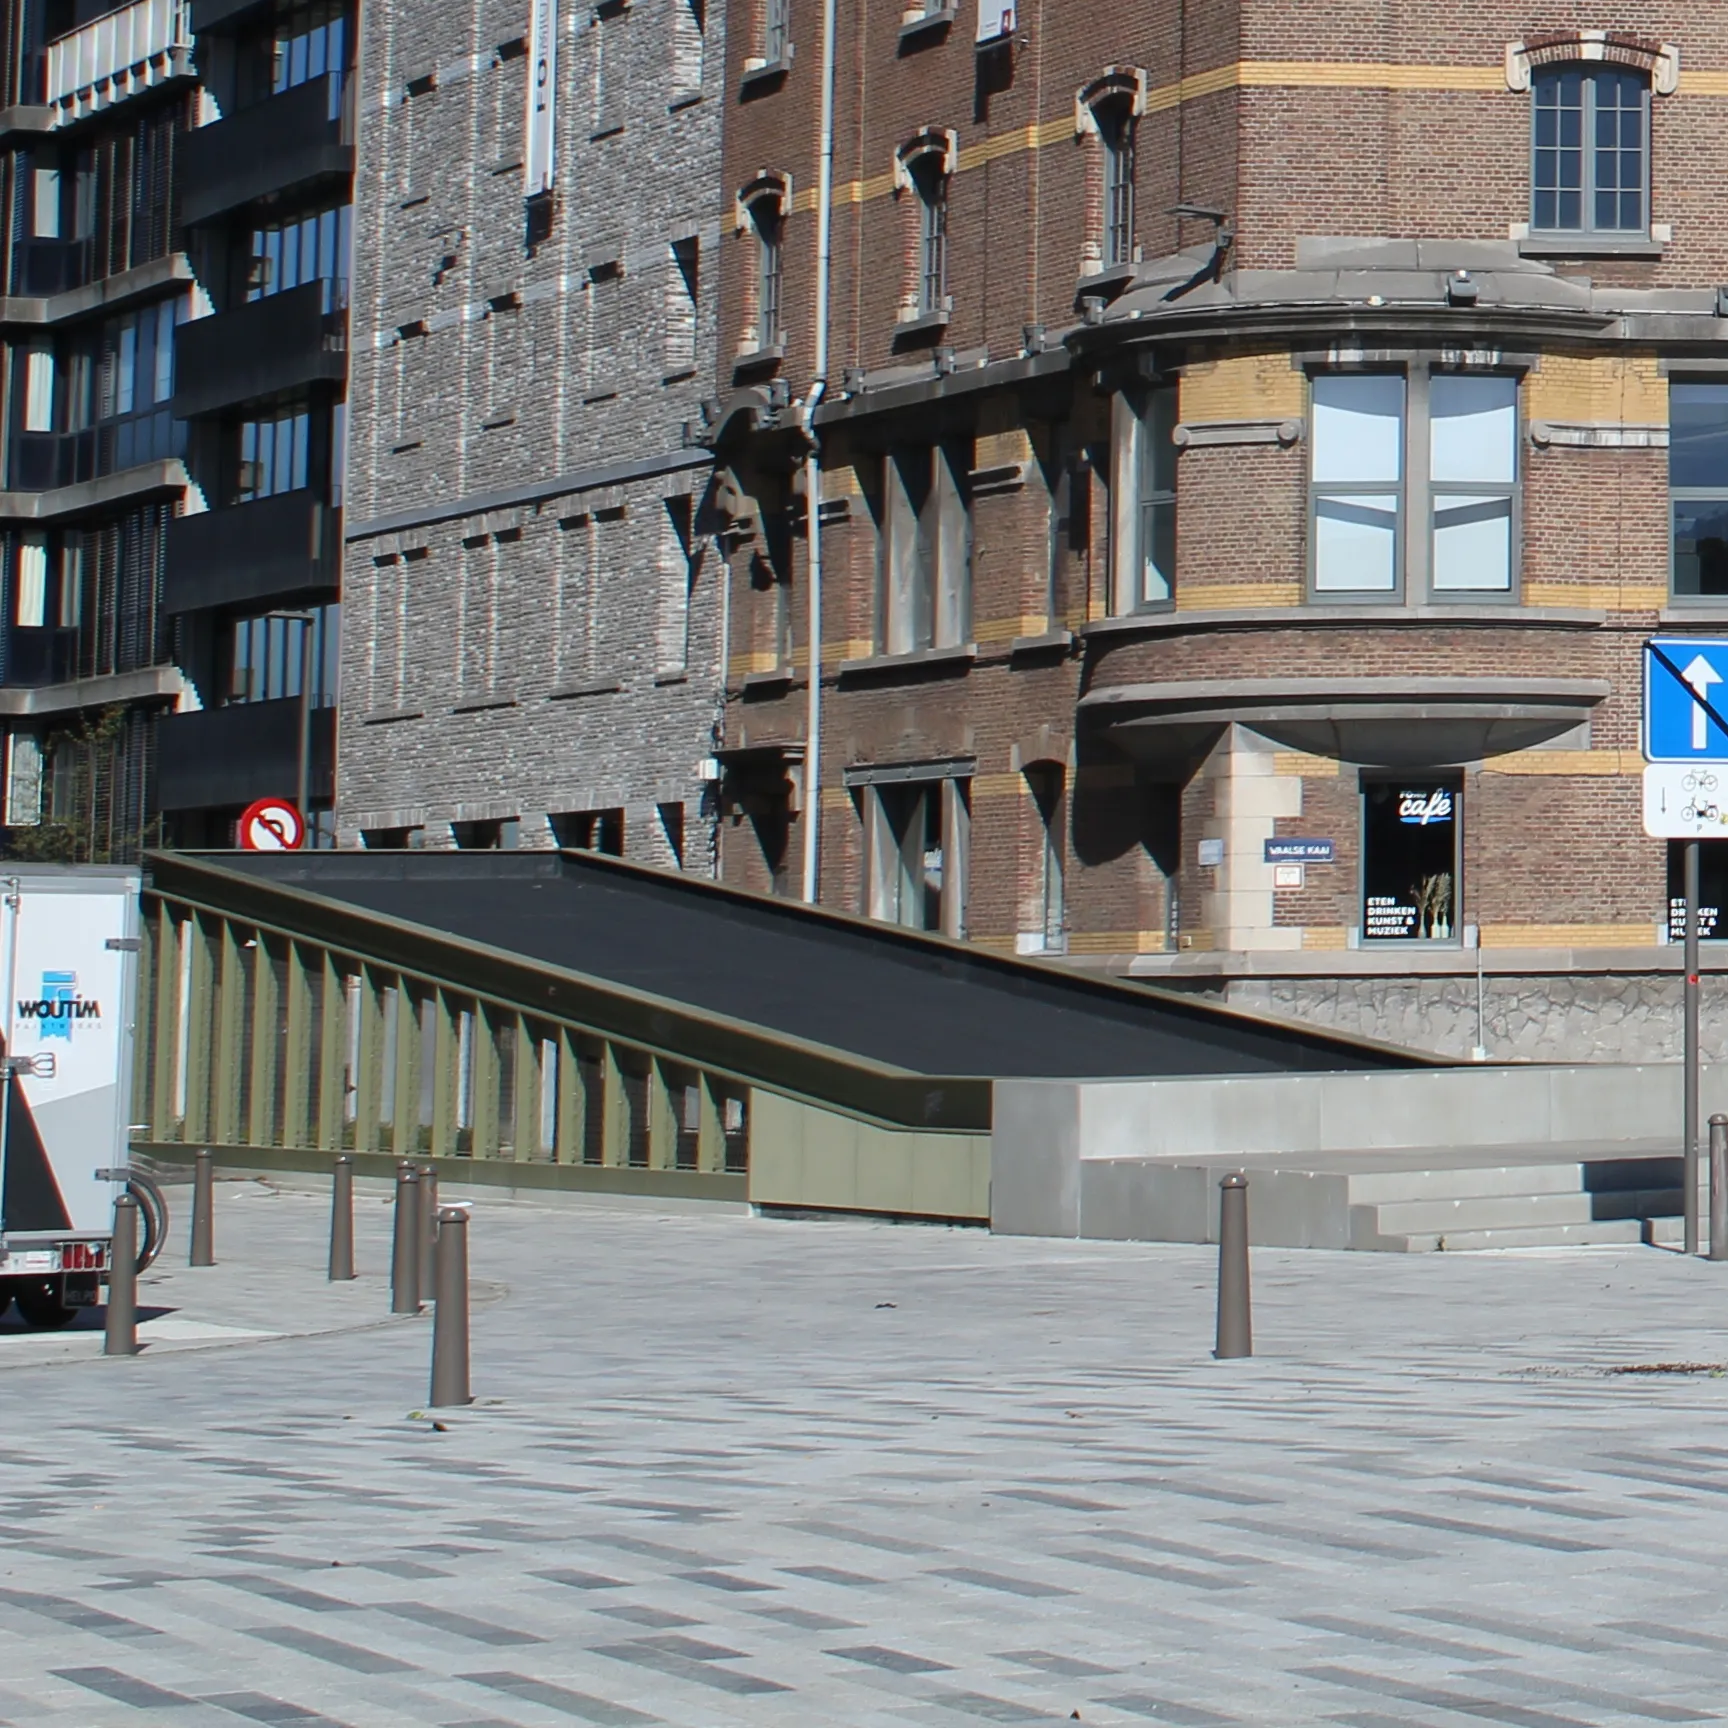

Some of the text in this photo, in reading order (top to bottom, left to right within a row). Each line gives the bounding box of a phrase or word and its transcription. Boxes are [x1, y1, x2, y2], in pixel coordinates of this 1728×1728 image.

[1399, 791, 1452, 825] café
[1269, 845, 1331, 856] WAALSE KAAI
[1367, 896, 1396, 906] ETEN
[1367, 906, 1417, 916] DRINKEN
[1670, 907, 1719, 918] DRKEN
[1367, 916, 1415, 926] KUNST &
[1708, 917, 1717, 927] &
[1367, 926, 1409, 936] MUZIEK
[1670, 926, 1712, 937] MUEK
